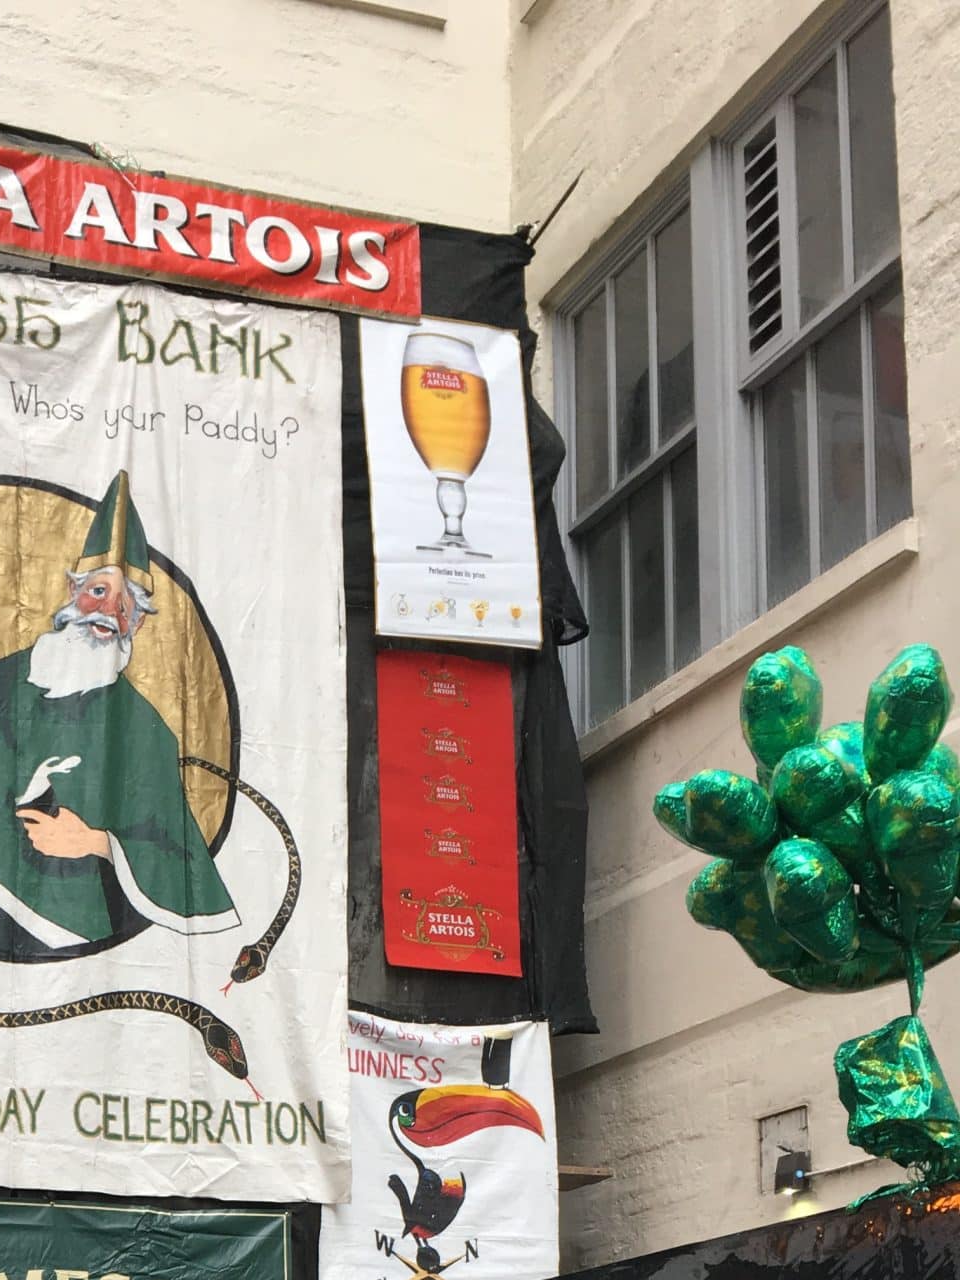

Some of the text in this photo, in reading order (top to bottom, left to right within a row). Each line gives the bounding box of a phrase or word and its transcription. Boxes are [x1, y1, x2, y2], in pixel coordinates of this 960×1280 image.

[63, 182, 390, 293] ARTOIS
[116, 299, 296, 384] BANK
[10, 381, 84, 422] Who's
[184, 403, 299, 459] Paddy?
[433, 681, 455, 689] STELLA
[435, 739, 457, 747] STELLA
[436, 786, 459, 794] STELLA
[438, 840, 460, 848] STELLA
[428, 912, 474, 925] STELLA
[429, 924, 475, 938] ARTOIS
[73, 1093, 326, 1145] CELEBRATION
[374, 1229, 394, 1257] W
[465, 1238, 479, 1263] N
